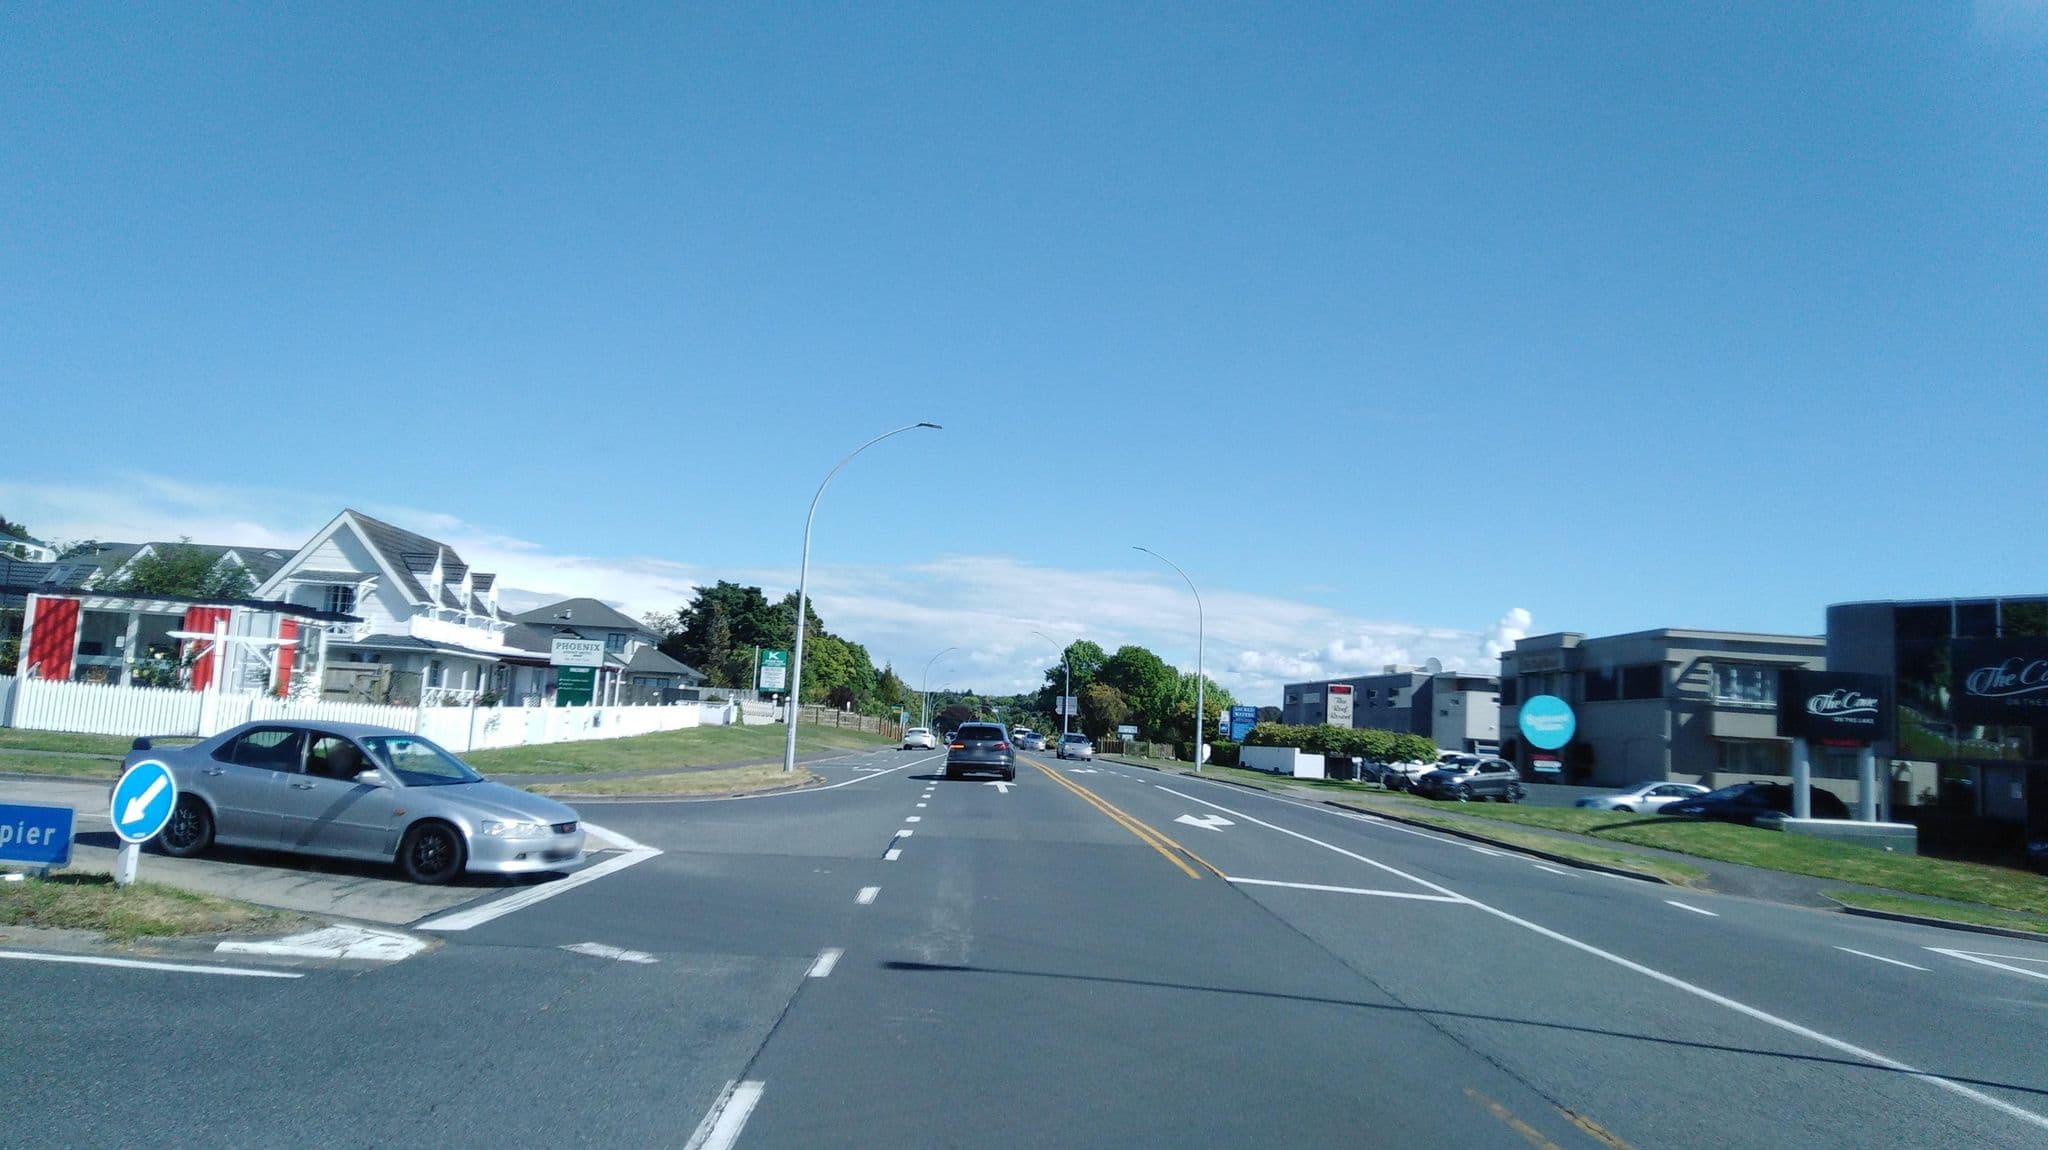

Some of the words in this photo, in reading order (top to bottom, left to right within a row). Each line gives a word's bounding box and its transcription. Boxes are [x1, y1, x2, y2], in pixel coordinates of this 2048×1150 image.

[555, 641, 601, 652] PHOENIX
[1965, 656, 2020, 696] The
[1807, 689, 1844, 714] The
